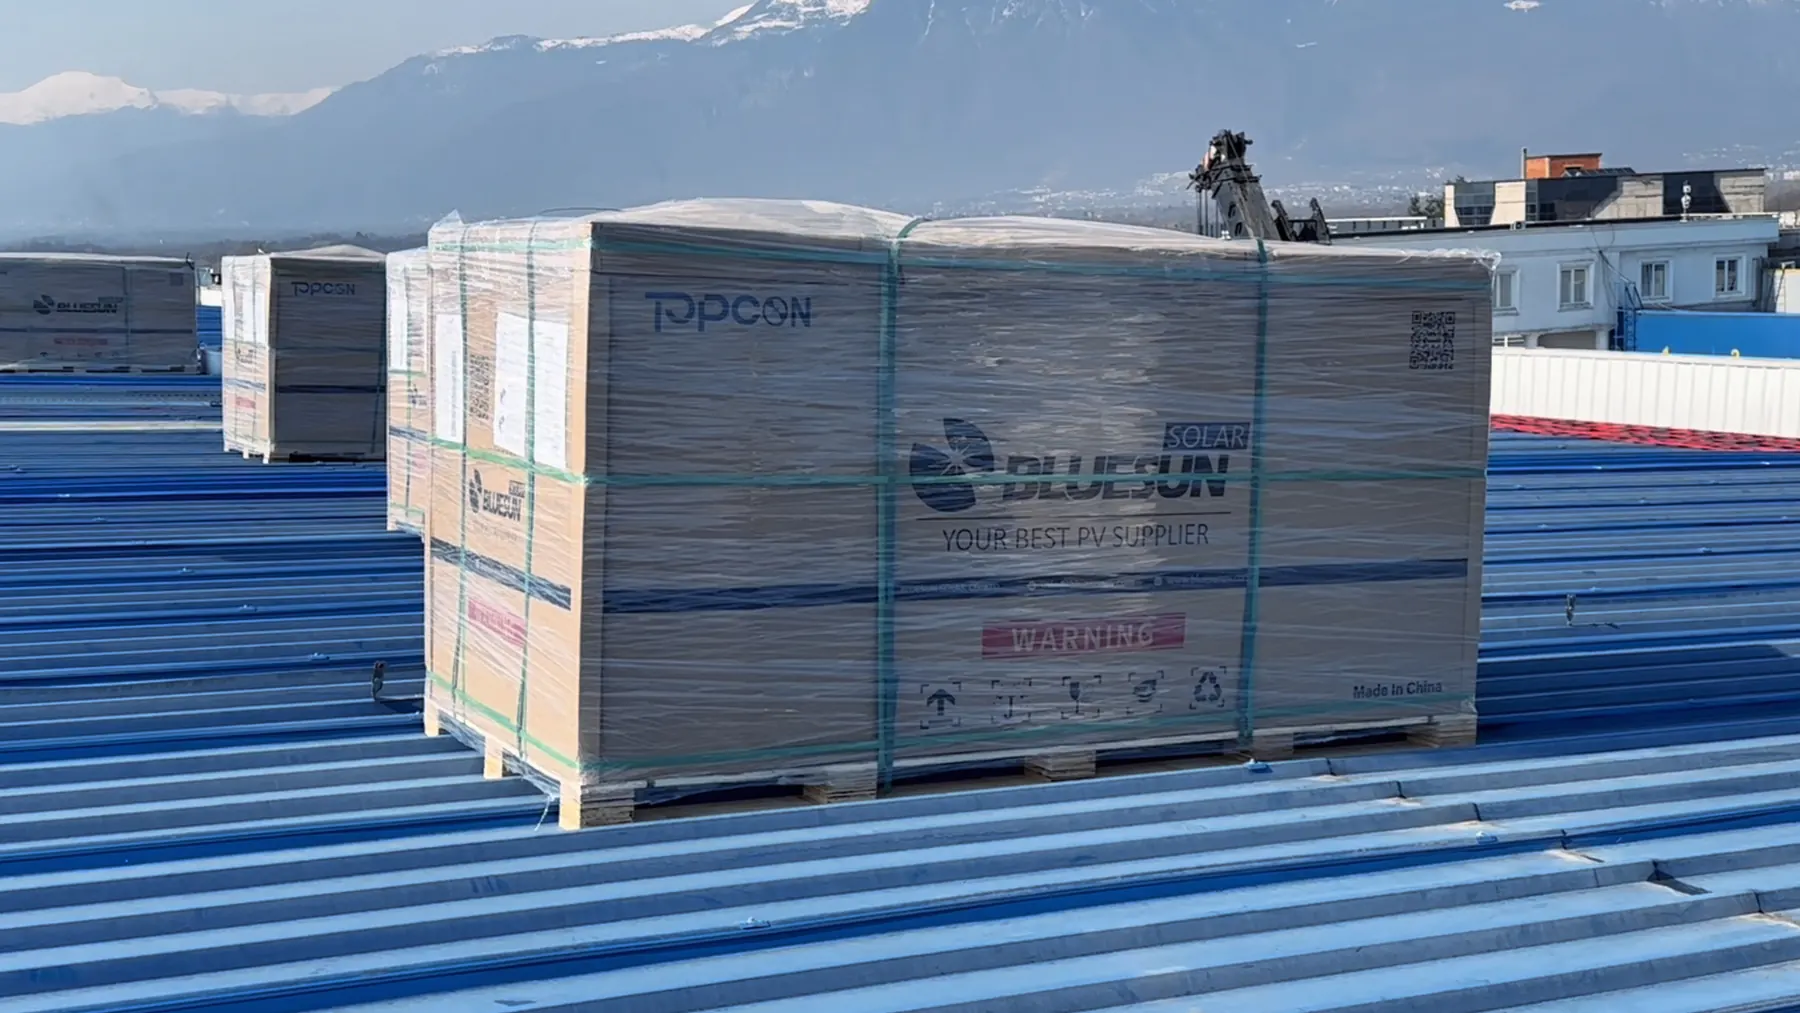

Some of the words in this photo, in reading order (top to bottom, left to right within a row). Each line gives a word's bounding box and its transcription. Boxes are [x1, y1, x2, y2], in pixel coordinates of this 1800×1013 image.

[291, 282, 355, 296] TOPCON
[645, 292, 811, 332] TOPCON
[1168, 425, 1245, 449] SOLAR
[1003, 454, 1229, 501] BLUESUN
[943, 528, 1007, 551] YOUR
[1016, 527, 1070, 549] BEST
[1078, 526, 1106, 548] PV
[1113, 523, 1209, 547] SUPPLIER
[1011, 622, 1155, 652] WARNING
[1353, 684, 1388, 699] Made
[1407, 680, 1442, 695] China
